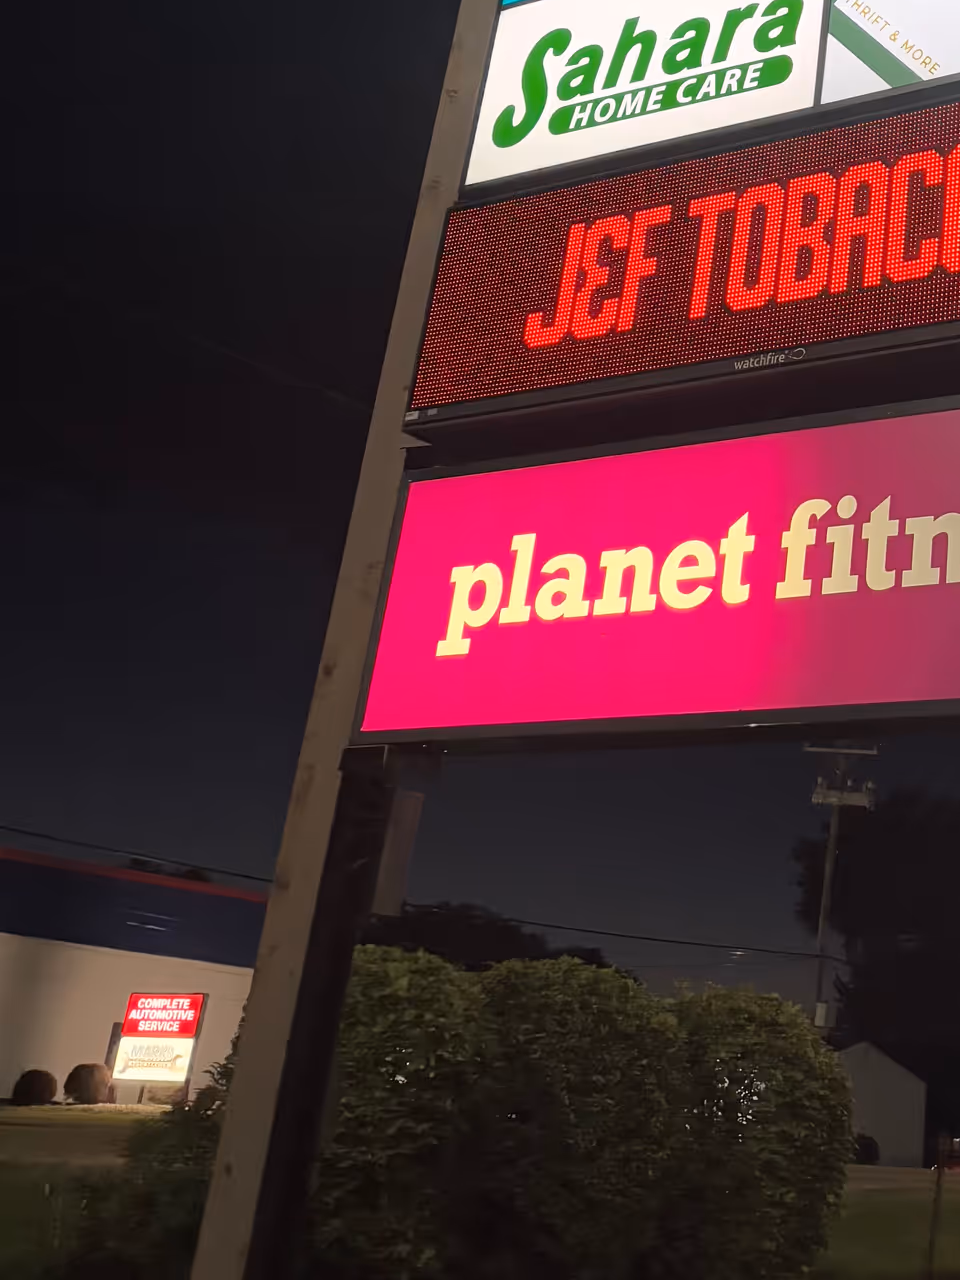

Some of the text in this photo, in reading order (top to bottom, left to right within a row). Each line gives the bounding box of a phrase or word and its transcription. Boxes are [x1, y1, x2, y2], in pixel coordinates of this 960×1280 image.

[888, 30, 900, 43] &
[900, 39, 941, 76] MORE
[568, 61, 764, 130] HOME CARE
[734, 351, 786, 370] watchfire
[434, 510, 755, 658] planet
[137, 998, 191, 1010] COMPLETE
[128, 1009, 195, 1021] AUTOMOTIVE
[137, 1021, 180, 1032] SERVICE
